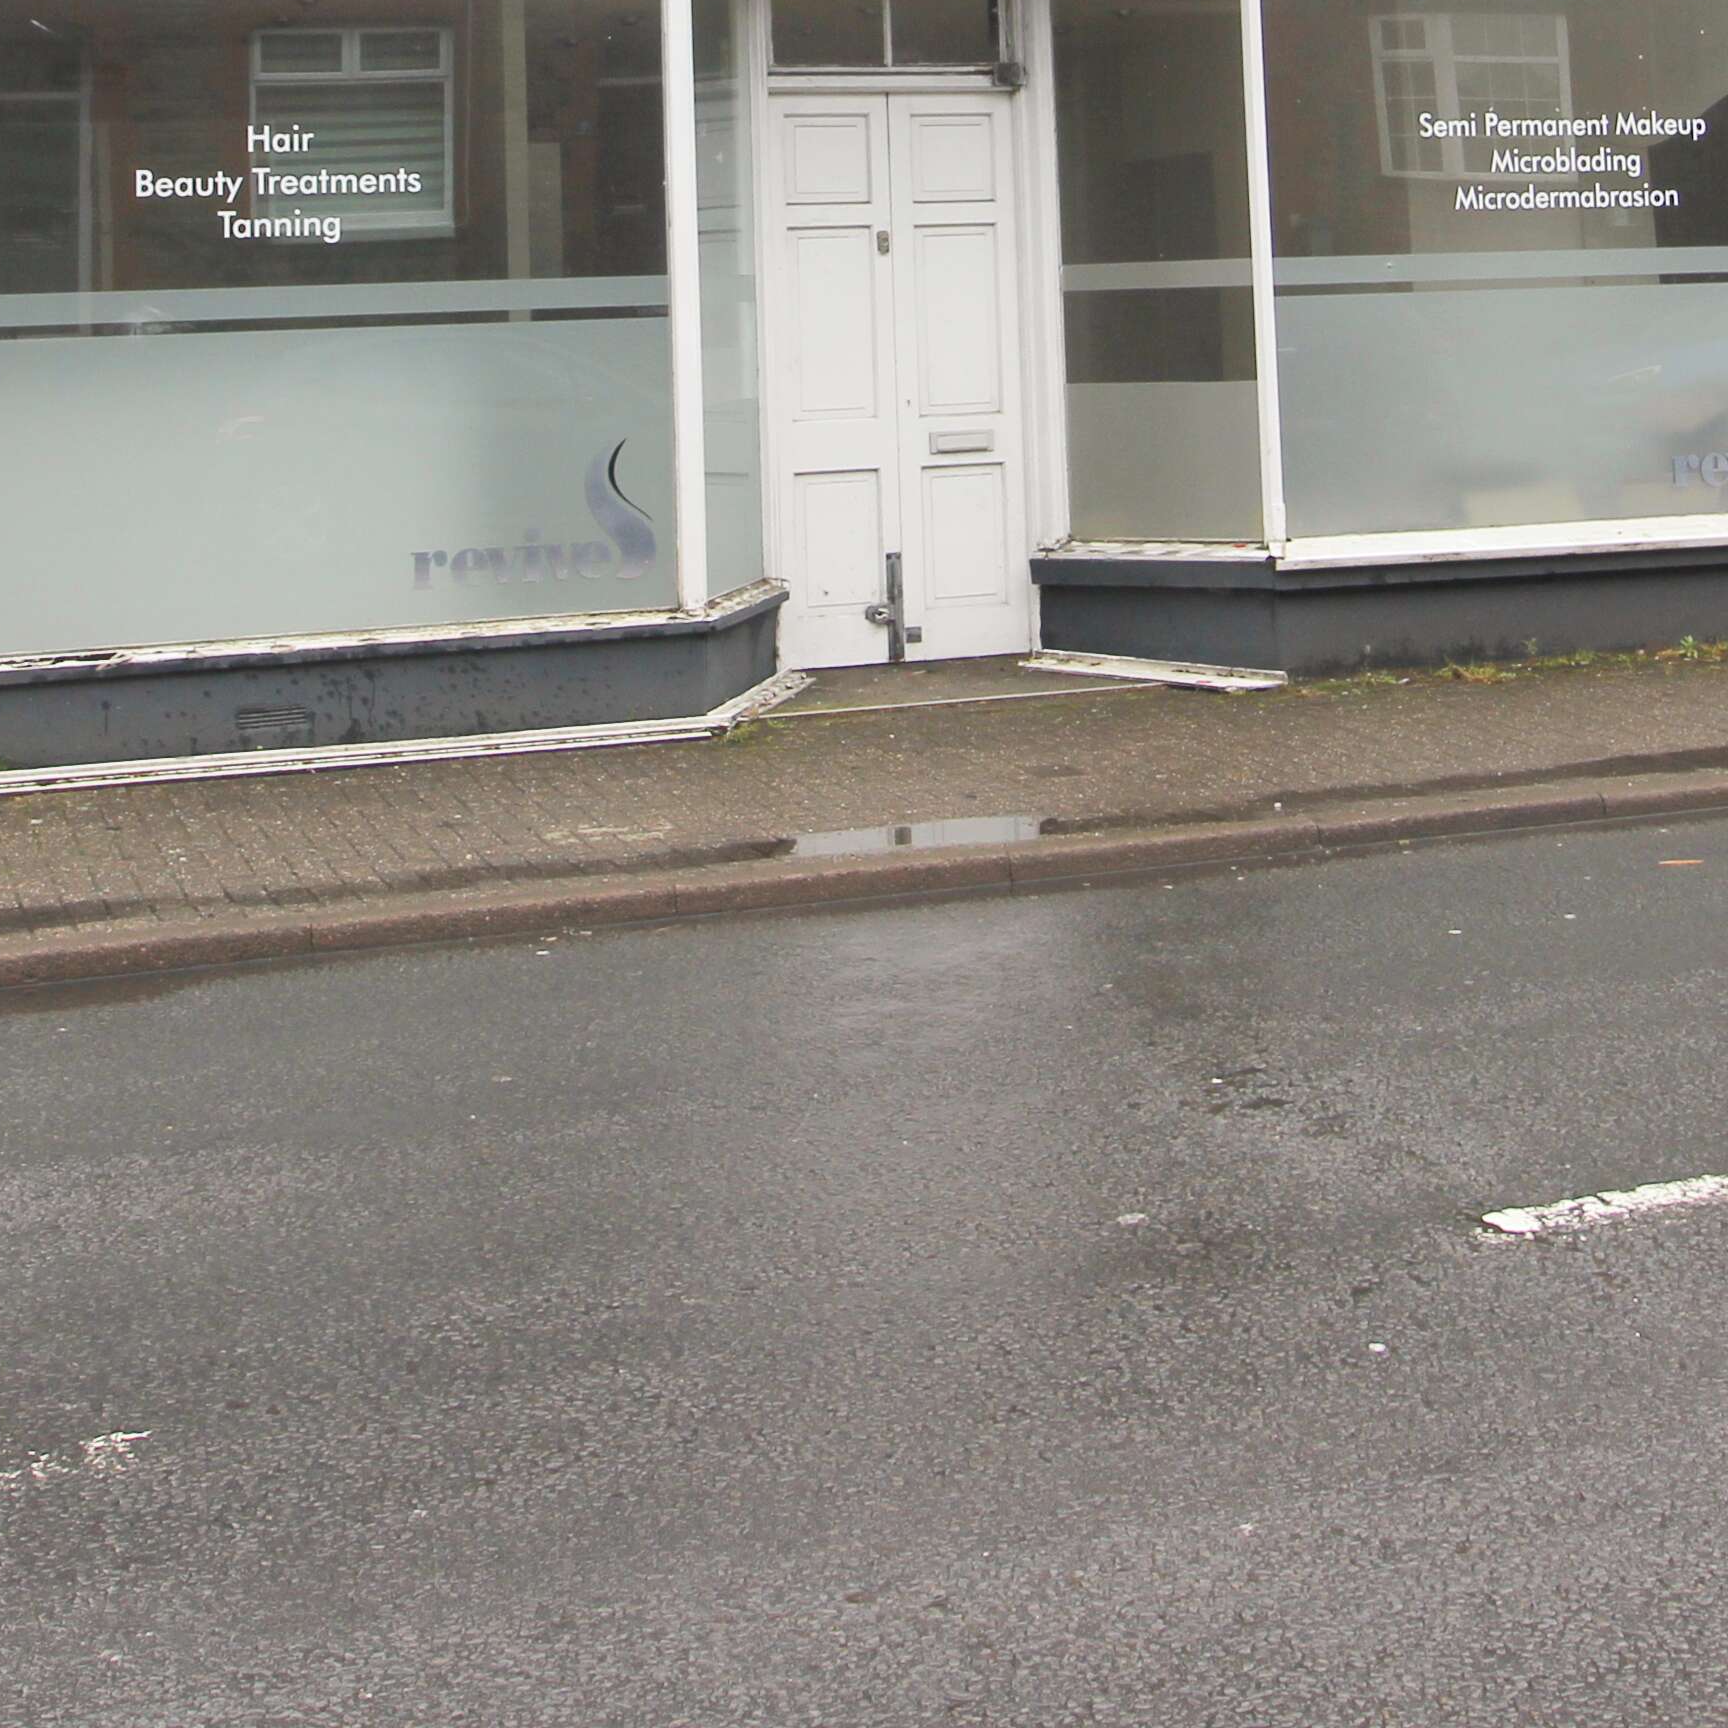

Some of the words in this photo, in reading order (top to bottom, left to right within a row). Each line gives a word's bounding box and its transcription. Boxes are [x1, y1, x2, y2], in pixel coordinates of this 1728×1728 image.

[247, 124, 315, 153] Hair
[1418, 111, 1476, 138] Semi
[1485, 111, 1608, 137] Permanent
[1616, 110, 1706, 140] Makeup
[1490, 147, 1641, 177] Microblading
[135, 169, 244, 203] Beauty
[251, 167, 422, 195] Treatments
[1455, 183, 1679, 210] Microdermabrasion
[217, 209, 341, 243] Tanning
